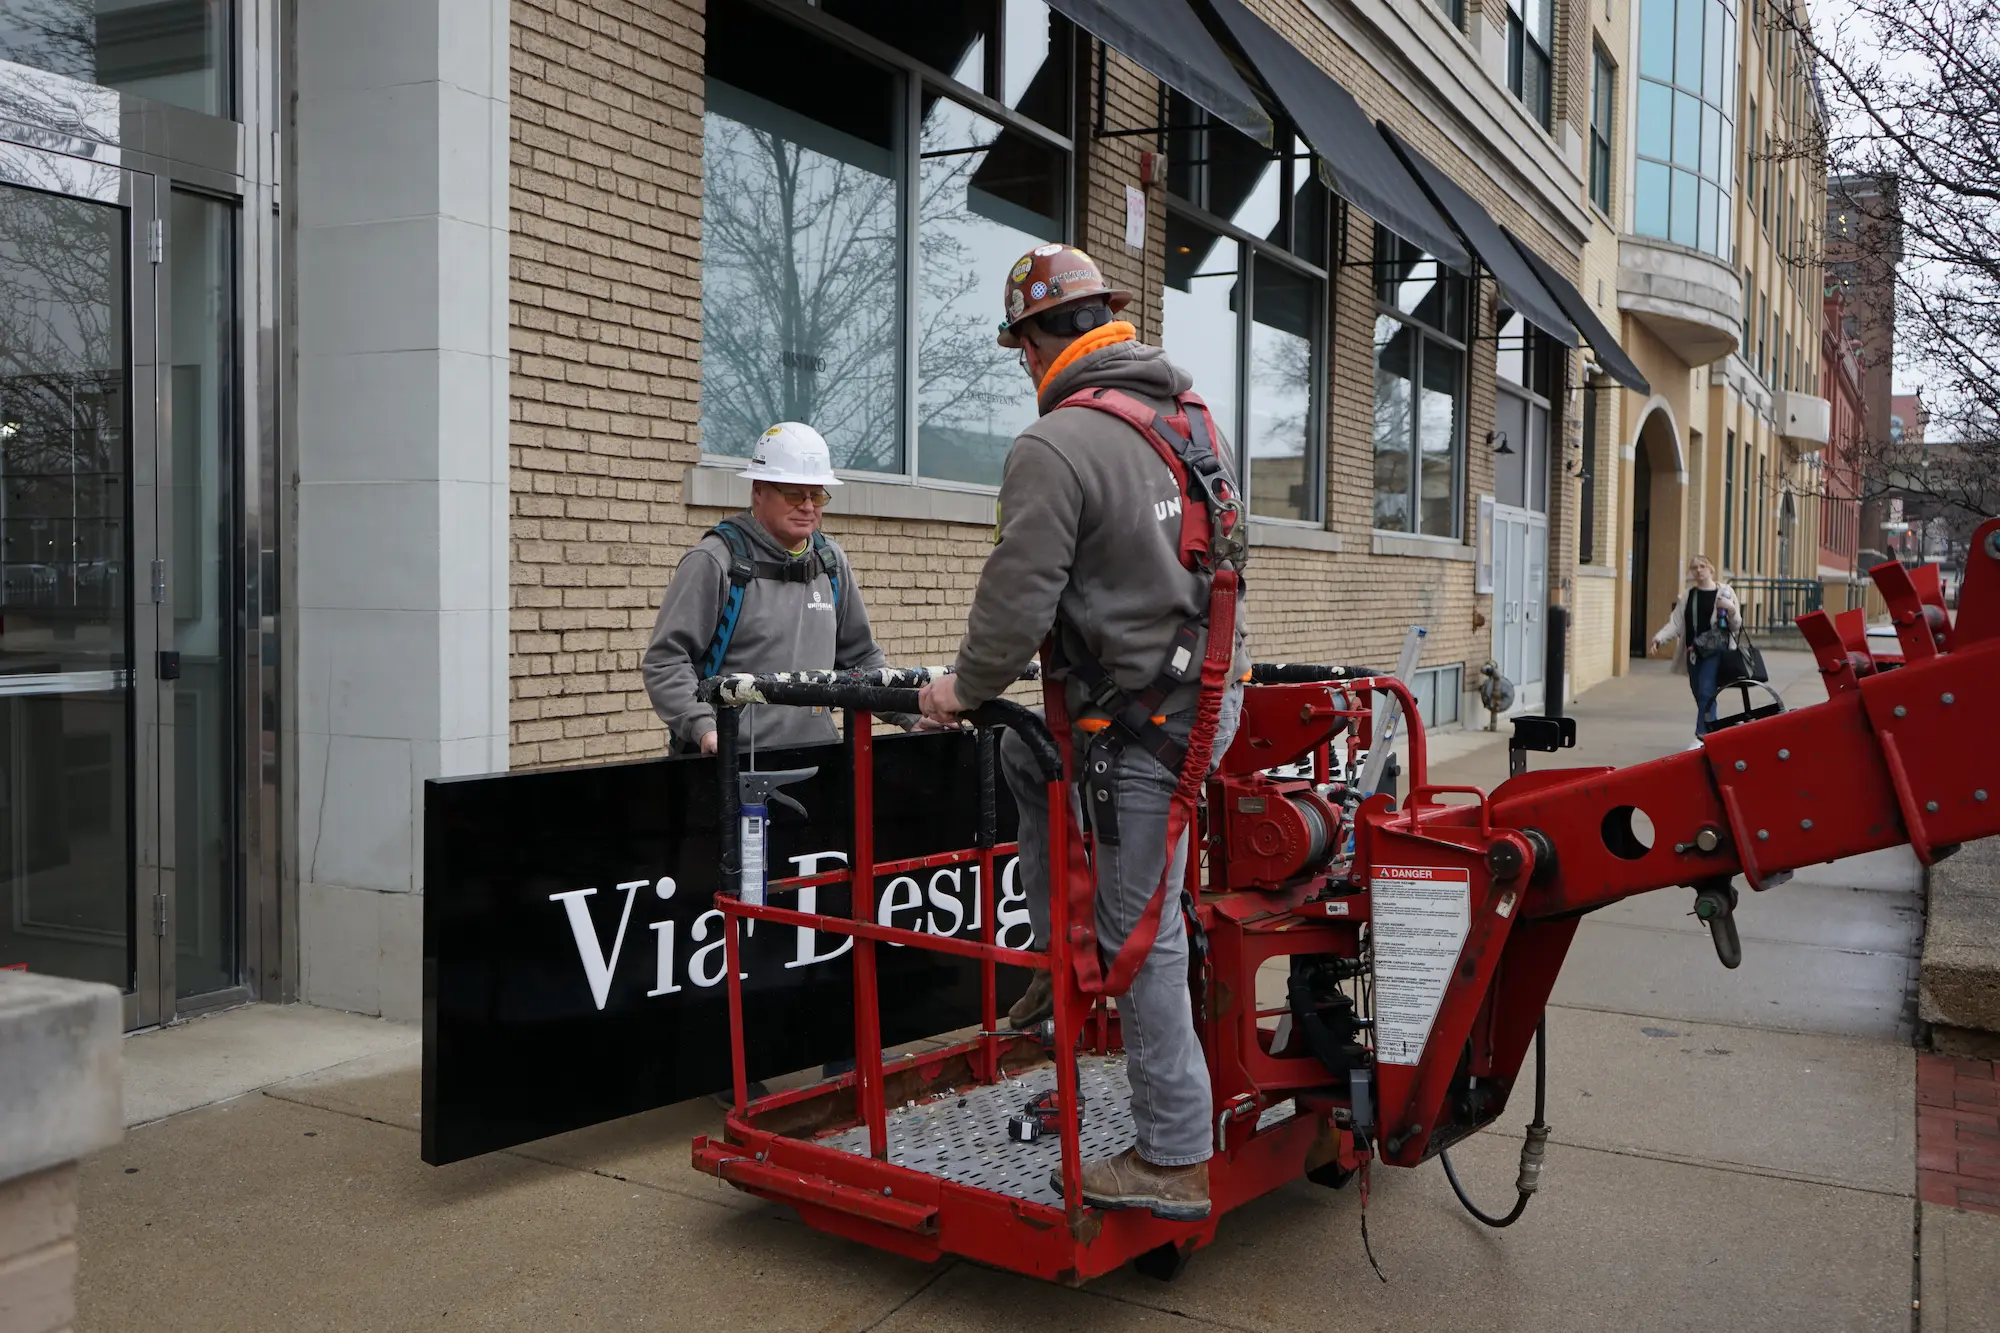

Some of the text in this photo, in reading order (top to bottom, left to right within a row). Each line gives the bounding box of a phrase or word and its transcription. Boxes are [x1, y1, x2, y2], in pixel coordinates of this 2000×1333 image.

[1391, 868, 1433, 879] DANGER
[549, 876, 749, 1011] Via
[784, 840, 1060, 969] Desig
